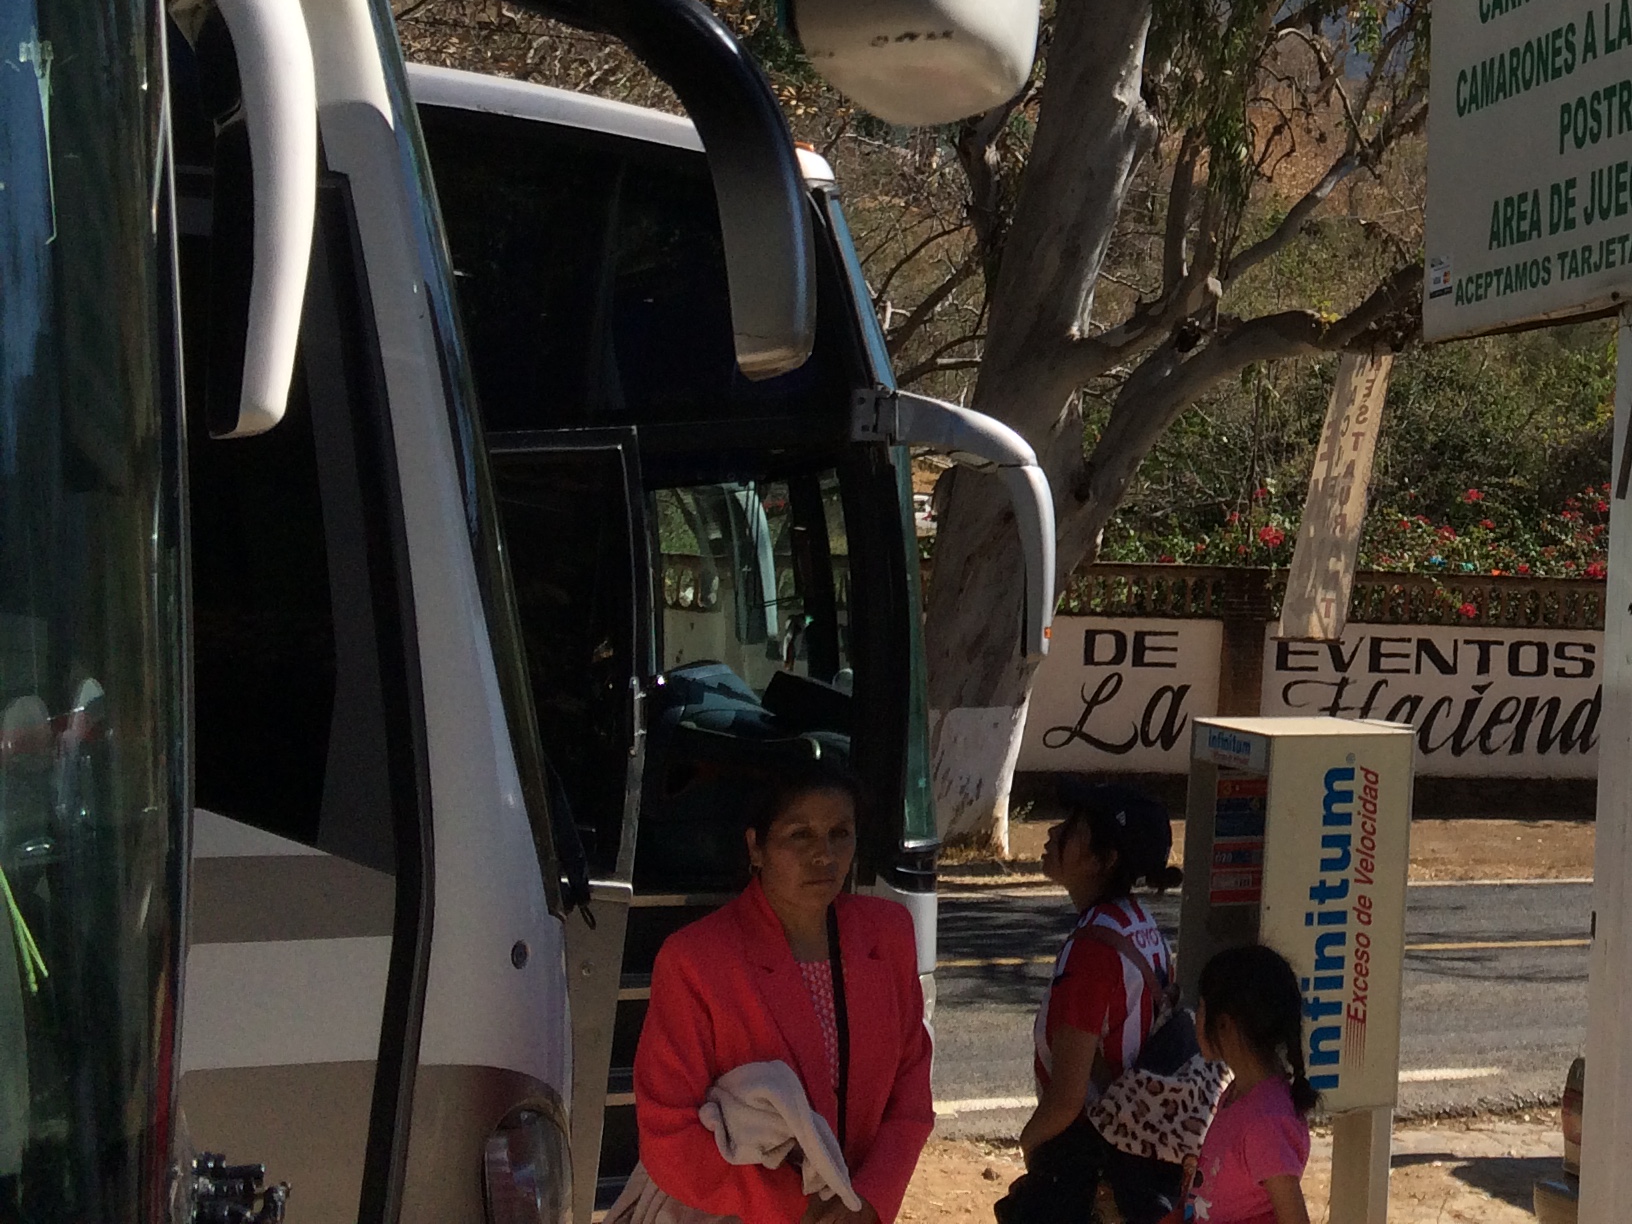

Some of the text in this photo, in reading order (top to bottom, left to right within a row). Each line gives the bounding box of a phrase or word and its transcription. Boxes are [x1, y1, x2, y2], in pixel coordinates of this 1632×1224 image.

[1456, 21, 1576, 118] CAMARONES
[1582, 11, 1597, 64] A
[1488, 187, 1541, 250] AREA
[1549, 177, 1576, 236] DE
[1455, 256, 1551, 306] ACEPTAMOS
[1084, 629, 1597, 678] DE EVENTOS
[1043, 672, 1191, 754] La
[1283, 677, 1602, 757] Haciend
[1300, 767, 1355, 1090] infinitum
[1347, 766, 1379, 1024] Exceso de Velocidad
